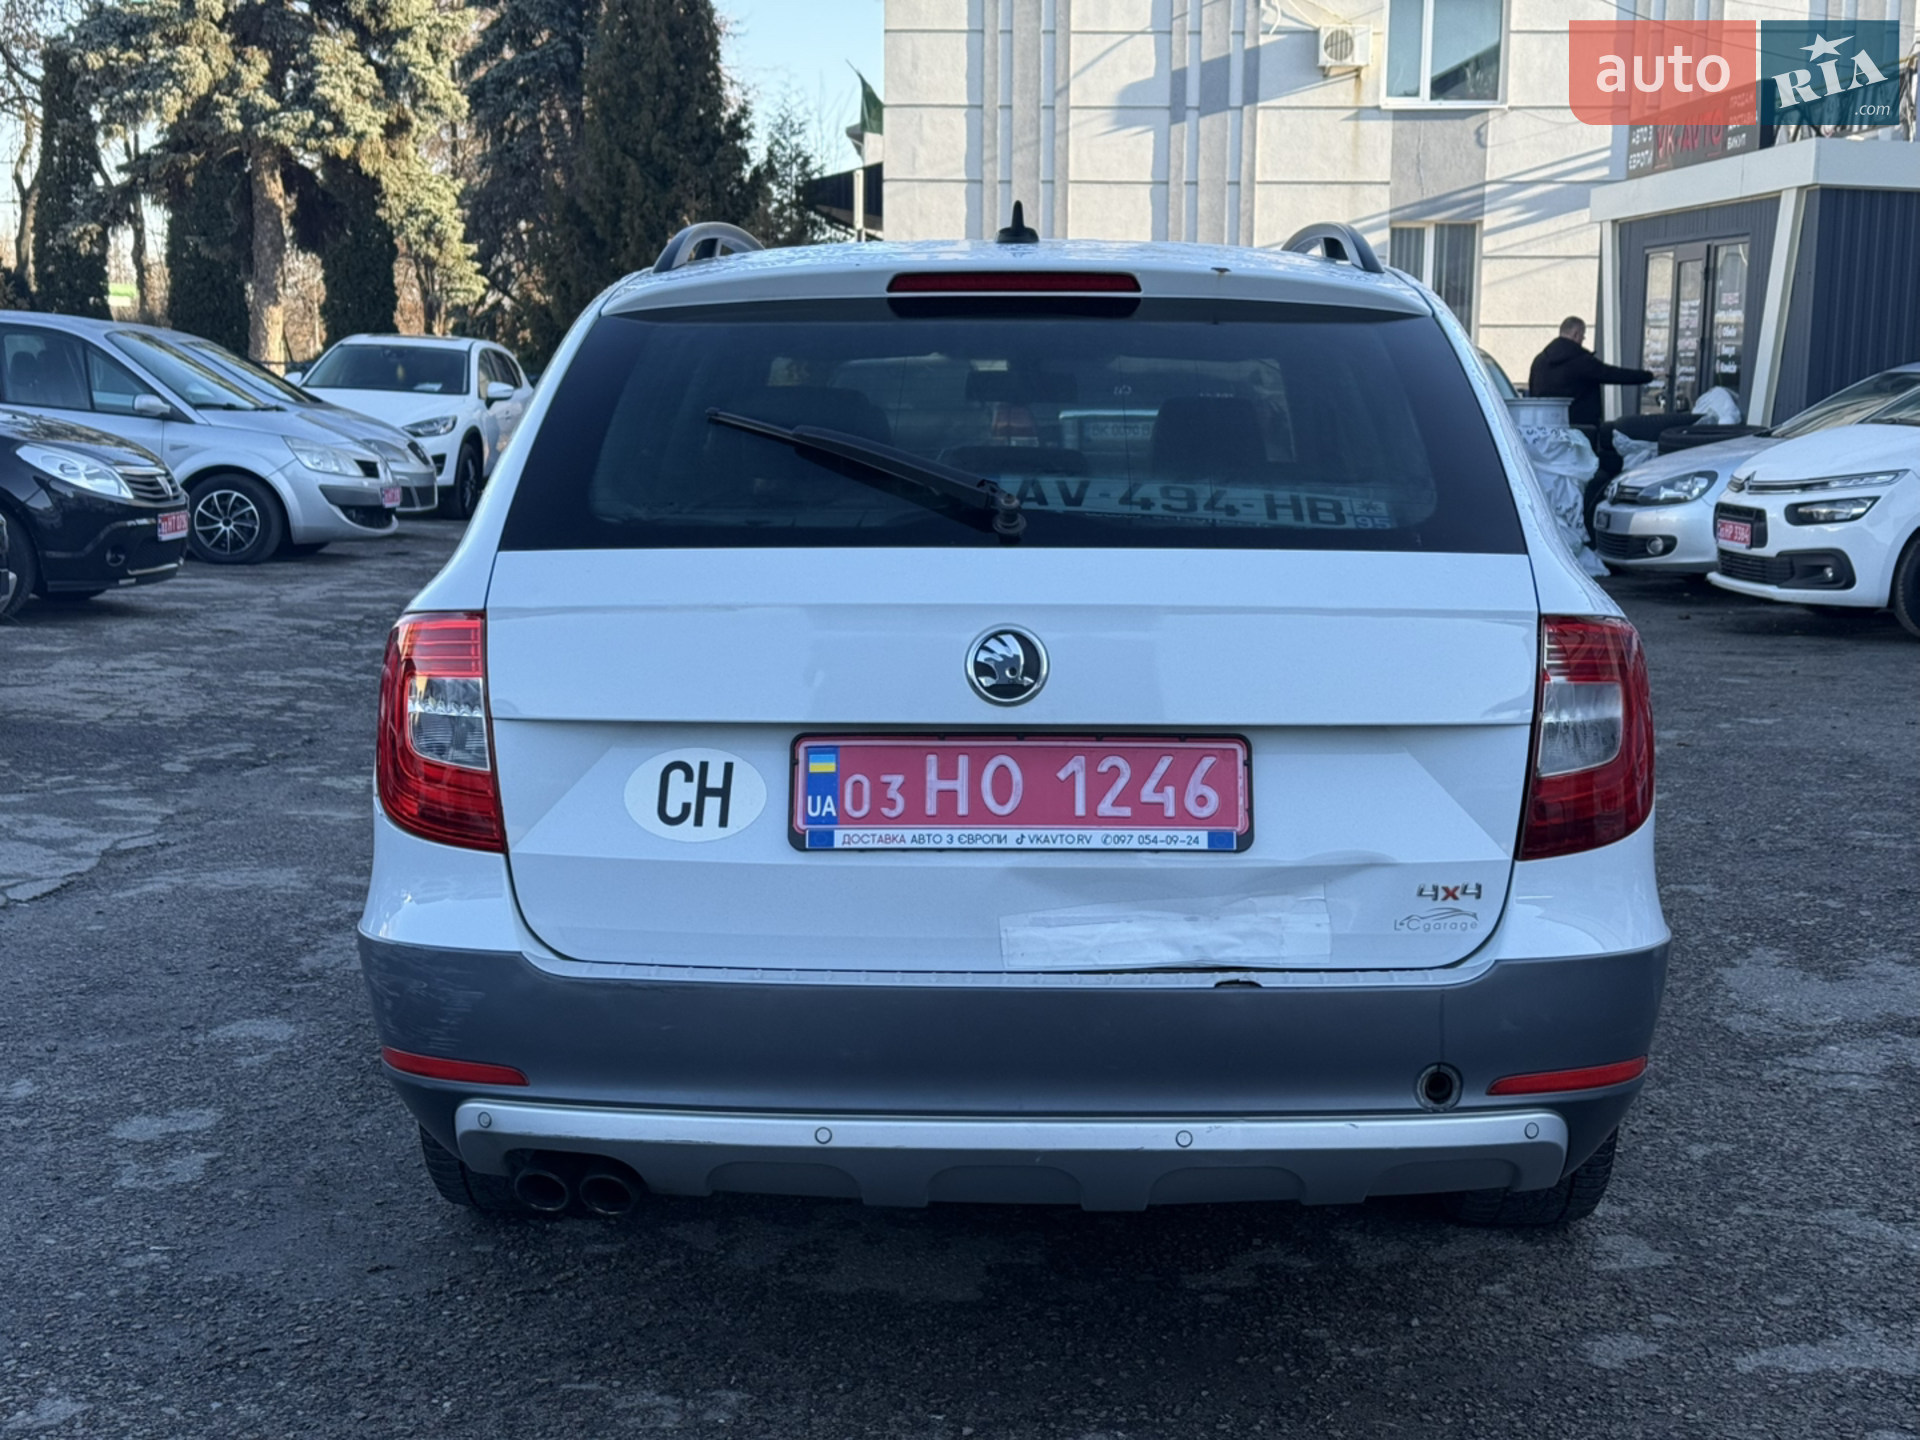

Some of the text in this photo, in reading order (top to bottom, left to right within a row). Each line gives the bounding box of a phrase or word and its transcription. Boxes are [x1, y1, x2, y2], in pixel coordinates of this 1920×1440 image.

[657, 760, 734, 828] CH
[844, 773, 905, 819] 03
[1055, 755, 1220, 818] 1246
[807, 795, 837, 817] UA
[842, 833, 906, 846] ДОСТАВКА
[910, 833, 943, 845] АВТО
[957, 833, 1008, 845] ЄВРОПИ
[1113, 834, 1200, 846] 097 054-09-24
[1416, 882, 1482, 901] 4x4
